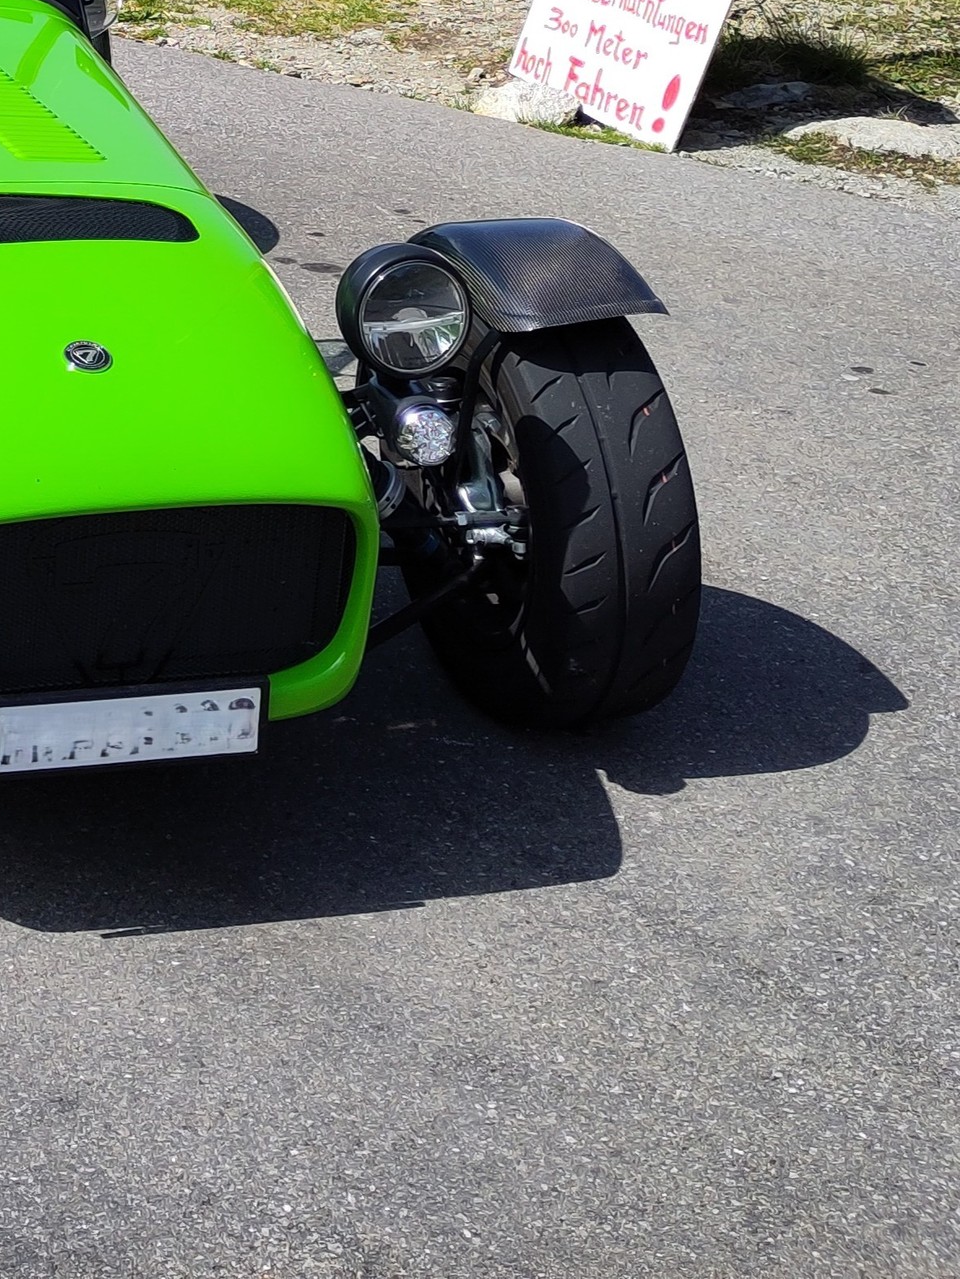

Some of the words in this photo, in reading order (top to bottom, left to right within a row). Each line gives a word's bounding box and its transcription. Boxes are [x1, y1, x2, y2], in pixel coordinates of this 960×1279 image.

[514, 37, 553, 85] hoch
[544, 6, 578, 38] 300
[584, 19, 648, 69] Meter
